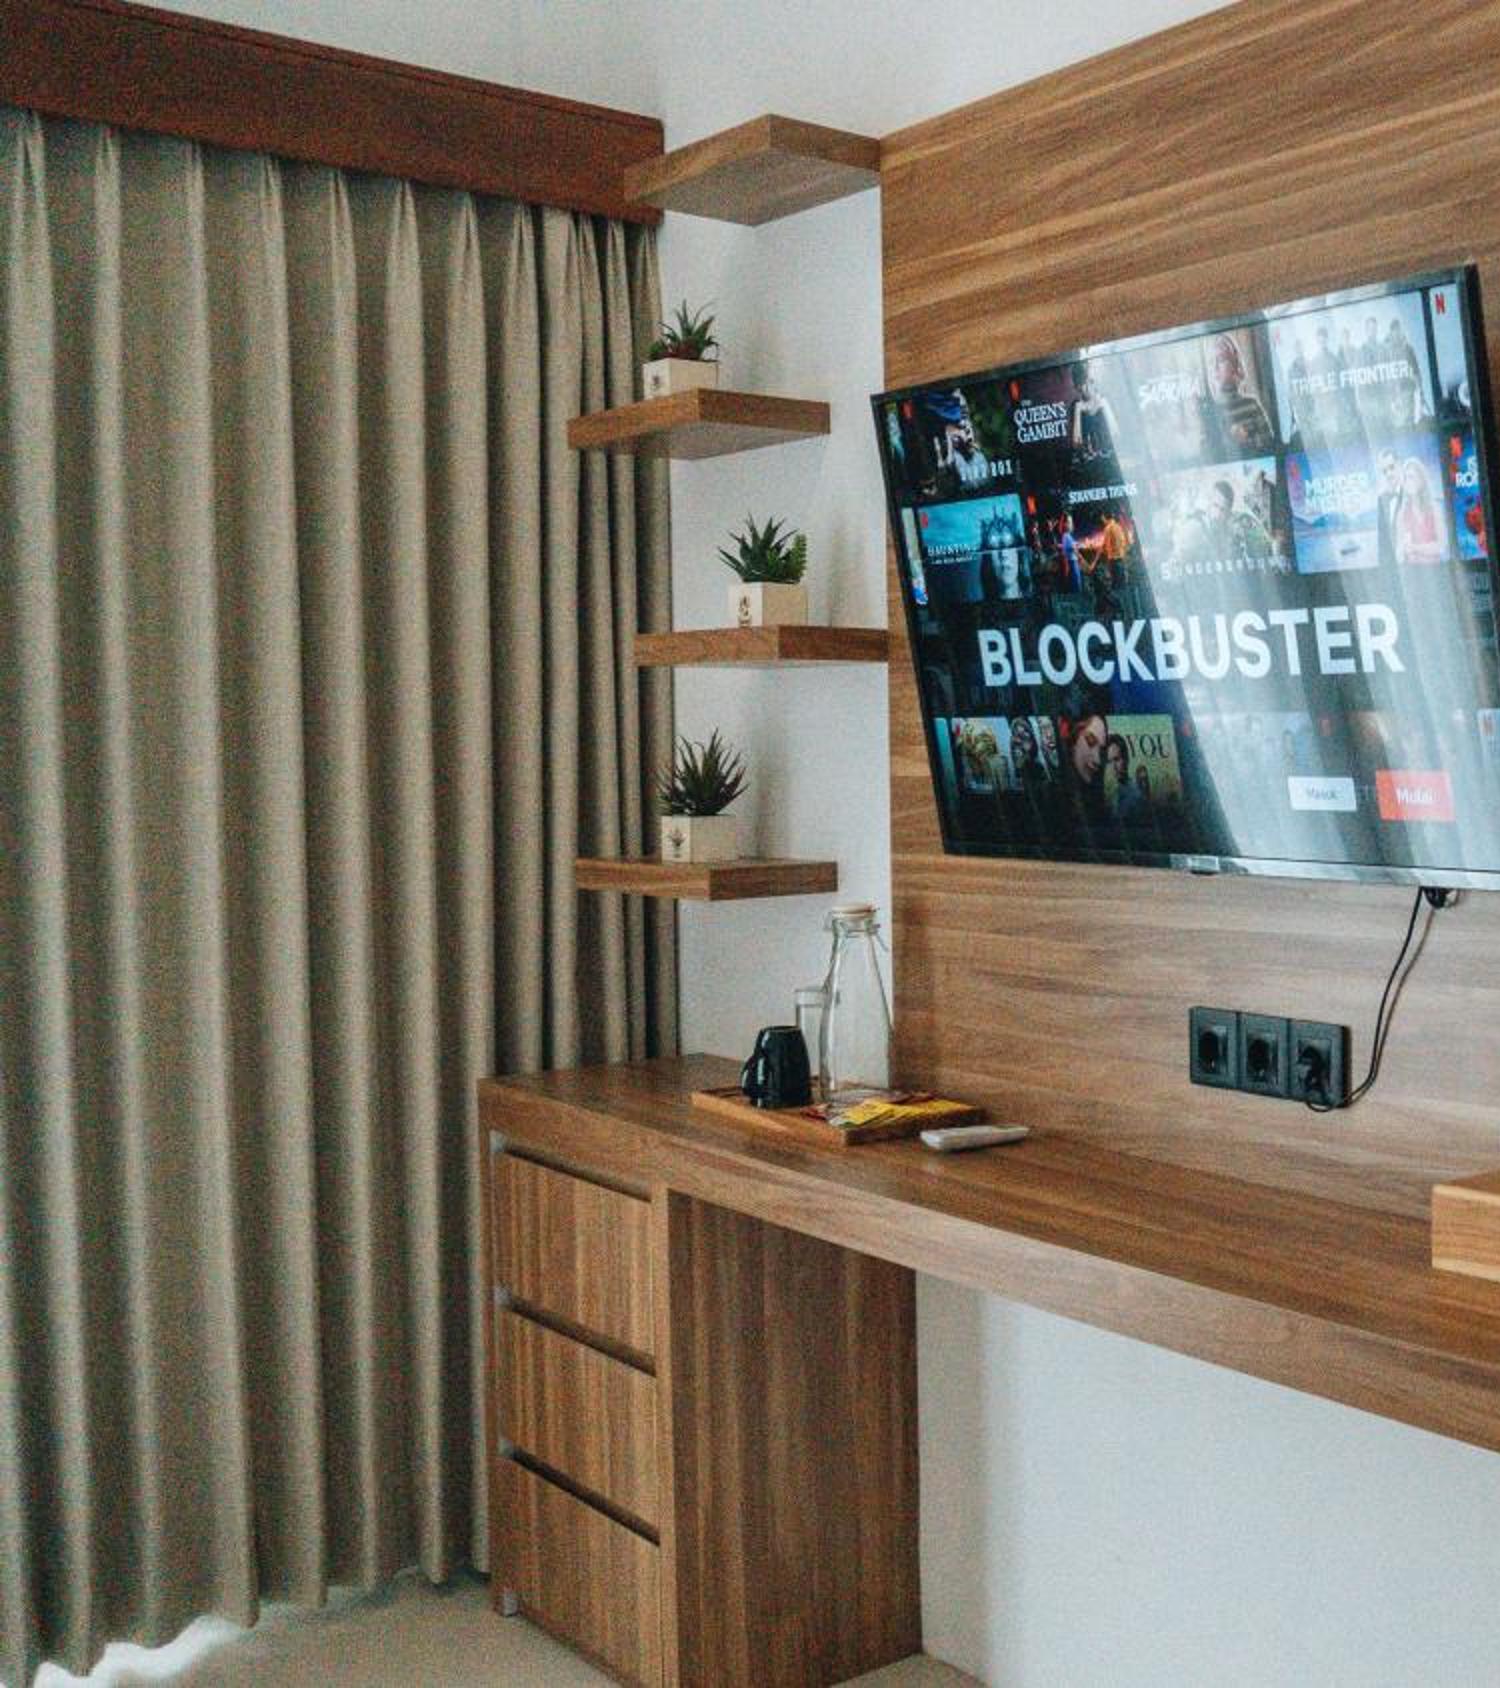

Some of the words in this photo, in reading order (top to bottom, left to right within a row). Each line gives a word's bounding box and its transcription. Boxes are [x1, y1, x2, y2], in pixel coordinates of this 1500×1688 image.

[1013, 401, 1067, 426] QUEEN'S
[1017, 419, 1068, 443] GAMBIT
[977, 603, 1405, 687] BLOCKBUSTER
[1125, 733, 1170, 758] YOU
